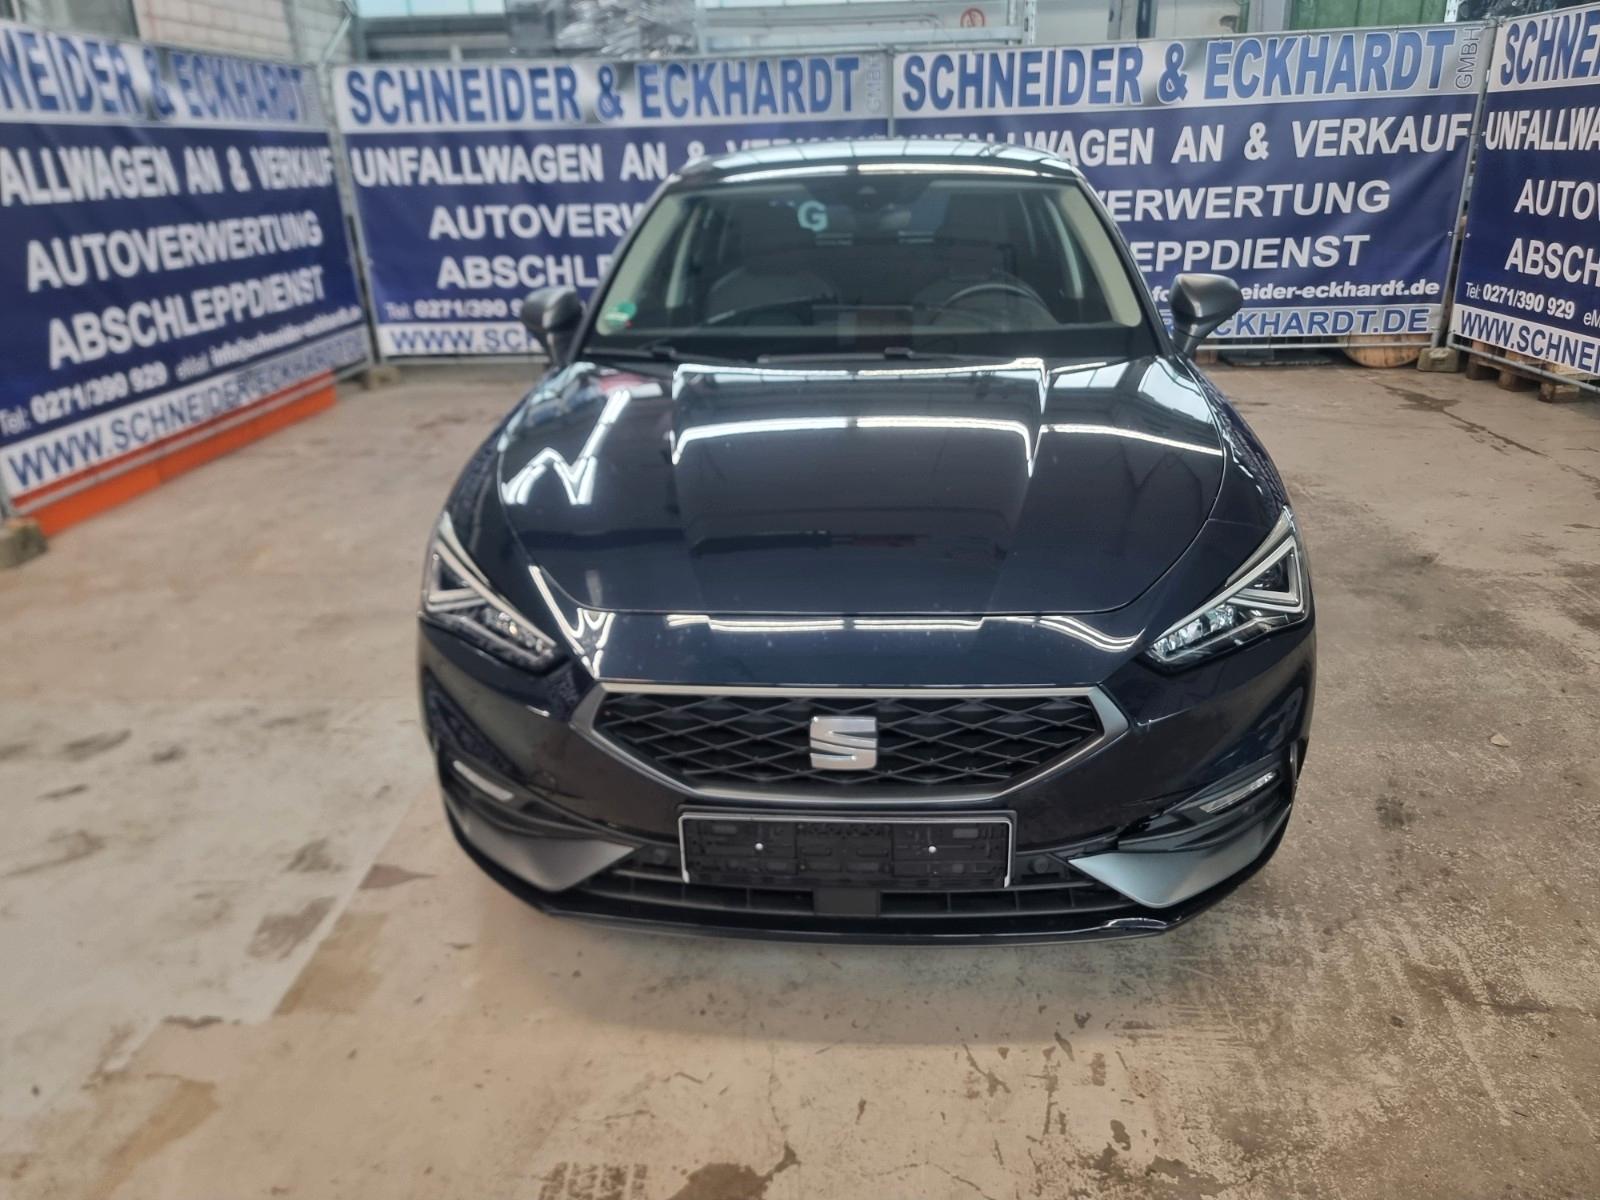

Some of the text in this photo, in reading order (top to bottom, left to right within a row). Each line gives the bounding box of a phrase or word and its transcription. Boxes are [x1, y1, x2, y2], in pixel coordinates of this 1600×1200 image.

[902, 29, 1458, 112] SCHNEIDER & ECKHARDT
[1455, 25, 1482, 90] GMBH
[346, 56, 860, 125] SCHNEIDER & ECKHARDT
[352, 144, 604, 187] UNFALLWAGEN
[620, 142, 668, 181] AN
[1171, 124, 1224, 163] AN
[1243, 122, 1270, 161] &
[1291, 113, 1473, 159] VERKAUF
[184, 146, 224, 195] AN
[226, 146, 252, 192] &
[1514, 178, 1600, 221] AUTO
[27, 210, 323, 293] AUTOVERWERTUNG
[50, 266, 325, 370] ABSCHLEPPDIENST
[1465, 282, 1482, 300] Tel:
[1482, 283, 1544, 313] 0271/390
[1547, 297, 1576, 320] 929
